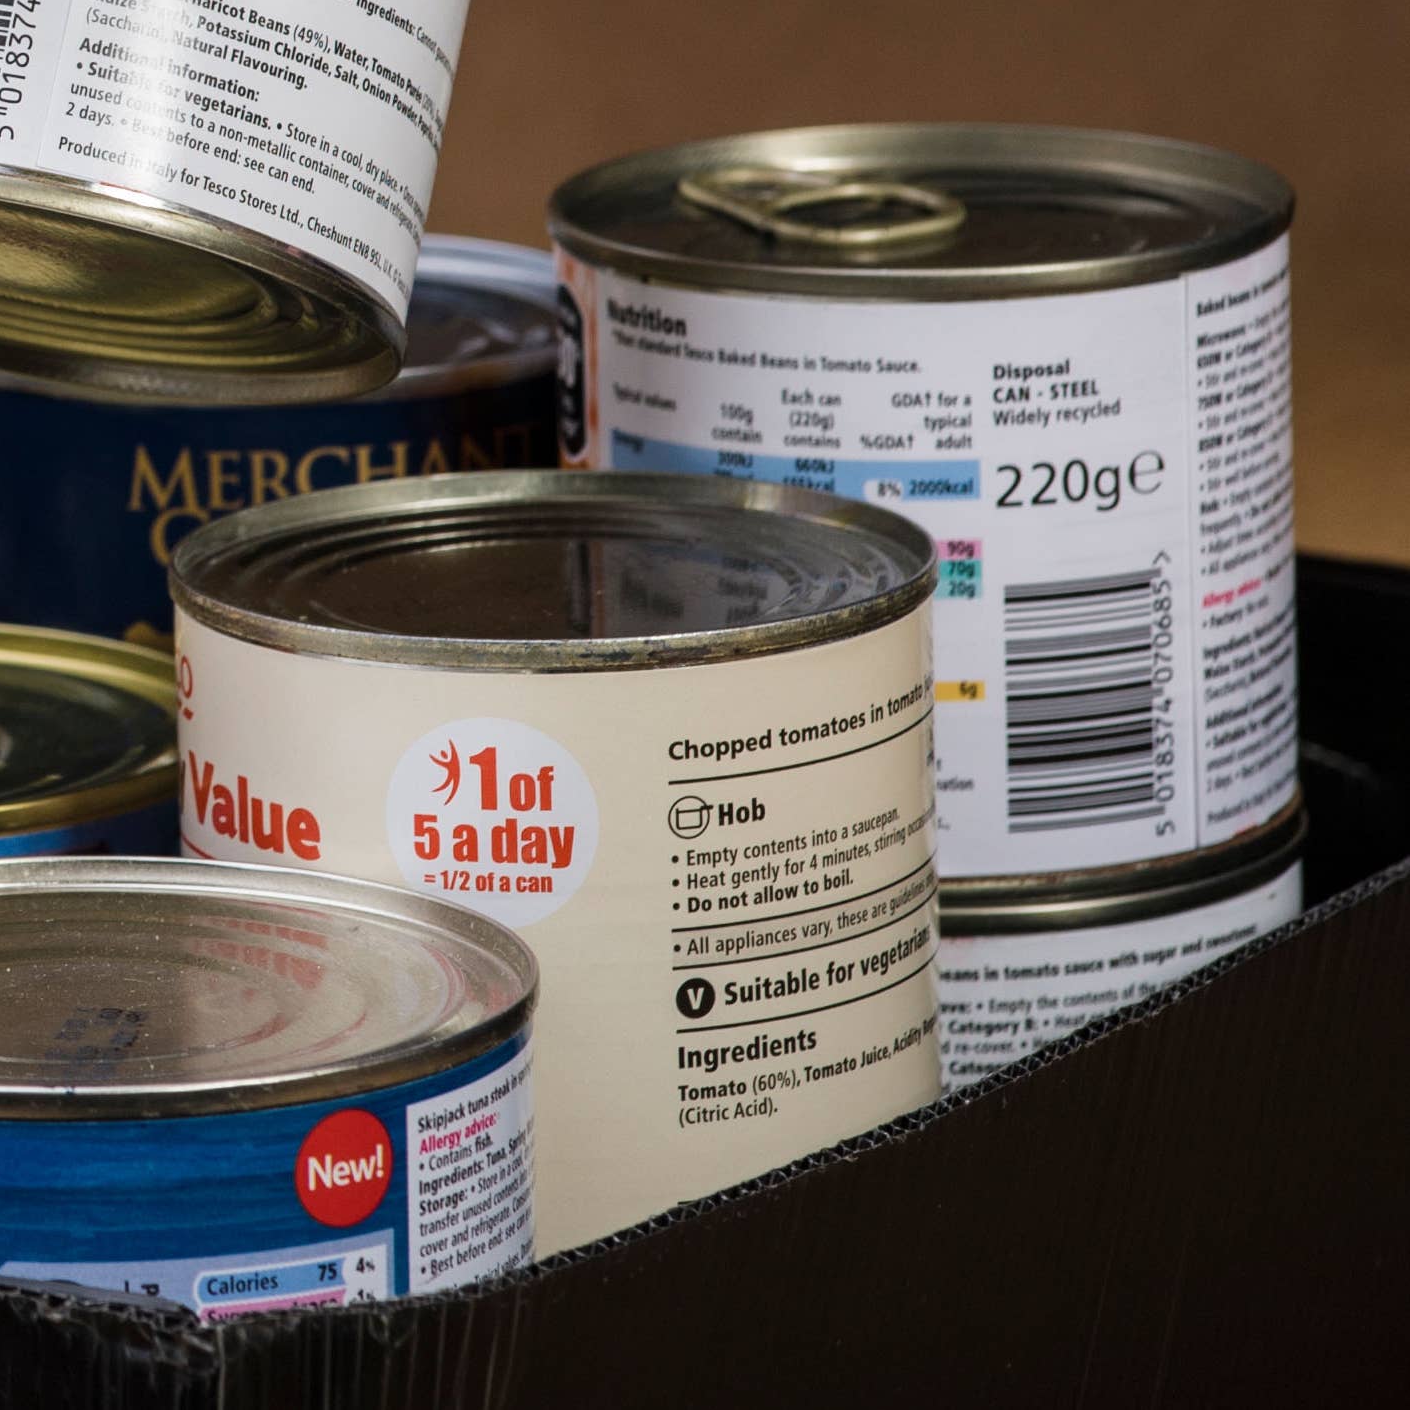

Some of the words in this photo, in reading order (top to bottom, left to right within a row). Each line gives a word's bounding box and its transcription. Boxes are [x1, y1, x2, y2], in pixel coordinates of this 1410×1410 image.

[197, 17, 270, 52] Potassium
[274, 40, 332, 77] Chloride,
[249, 10, 290, 36] Beans
[293, 24, 331, 54] (49%),
[334, 40, 369, 72] Water,
[231, 49, 307, 89] Flavouring.
[184, 89, 271, 130] vegetarians.
[181, 168, 200, 187] for
[203, 176, 237, 202] Tesco
[239, 189, 277, 216] Stores
[280, 205, 304, 229] Ltd.,
[993, 360, 1071, 382] Disposal
[993, 385, 1030, 405] CAN
[1050, 380, 1099, 400] STEEL
[993, 407, 1051, 430] Widely
[1056, 400, 1121, 421] recycled
[668, 729, 772, 761] Chopped
[778, 711, 866, 746] tomatoes
[870, 704, 884, 724] in
[887, 680, 923, 716] tomato
[470, 746, 498, 811] 1
[509, 766, 555, 812] of
[188, 750, 321, 862] Value
[718, 797, 765, 826] Hob
[413, 814, 441, 861] 5
[453, 824, 479, 863] a
[491, 818, 575, 869] day
[440, 870, 471, 891] 1/2
[475, 872, 495, 893] of
[499, 876, 513, 893] a
[516, 874, 553, 893] can
[687, 898, 712, 913] Do
[718, 891, 747, 910] not
[753, 883, 798, 905] allow
[804, 877, 819, 895] to
[823, 868, 853, 891] boil.
[724, 970, 820, 1005] Suitable
[826, 961, 854, 987] for
[678, 1030, 817, 1073] Ingredients
[678, 1079, 747, 1101] Tomato
[753, 1071, 801, 1095] (60%),
[804, 1058, 857, 1083] Tomato
[418, 1103, 466, 1134] Skipjack
[468, 1092, 489, 1114] tuna
[679, 1103, 730, 1127] (Citric
[734, 1098, 778, 1119] Acid).
[307, 1144, 385, 1192] New!
[207, 1273, 279, 1297] Calories
[318, 1263, 337, 1281] 75
